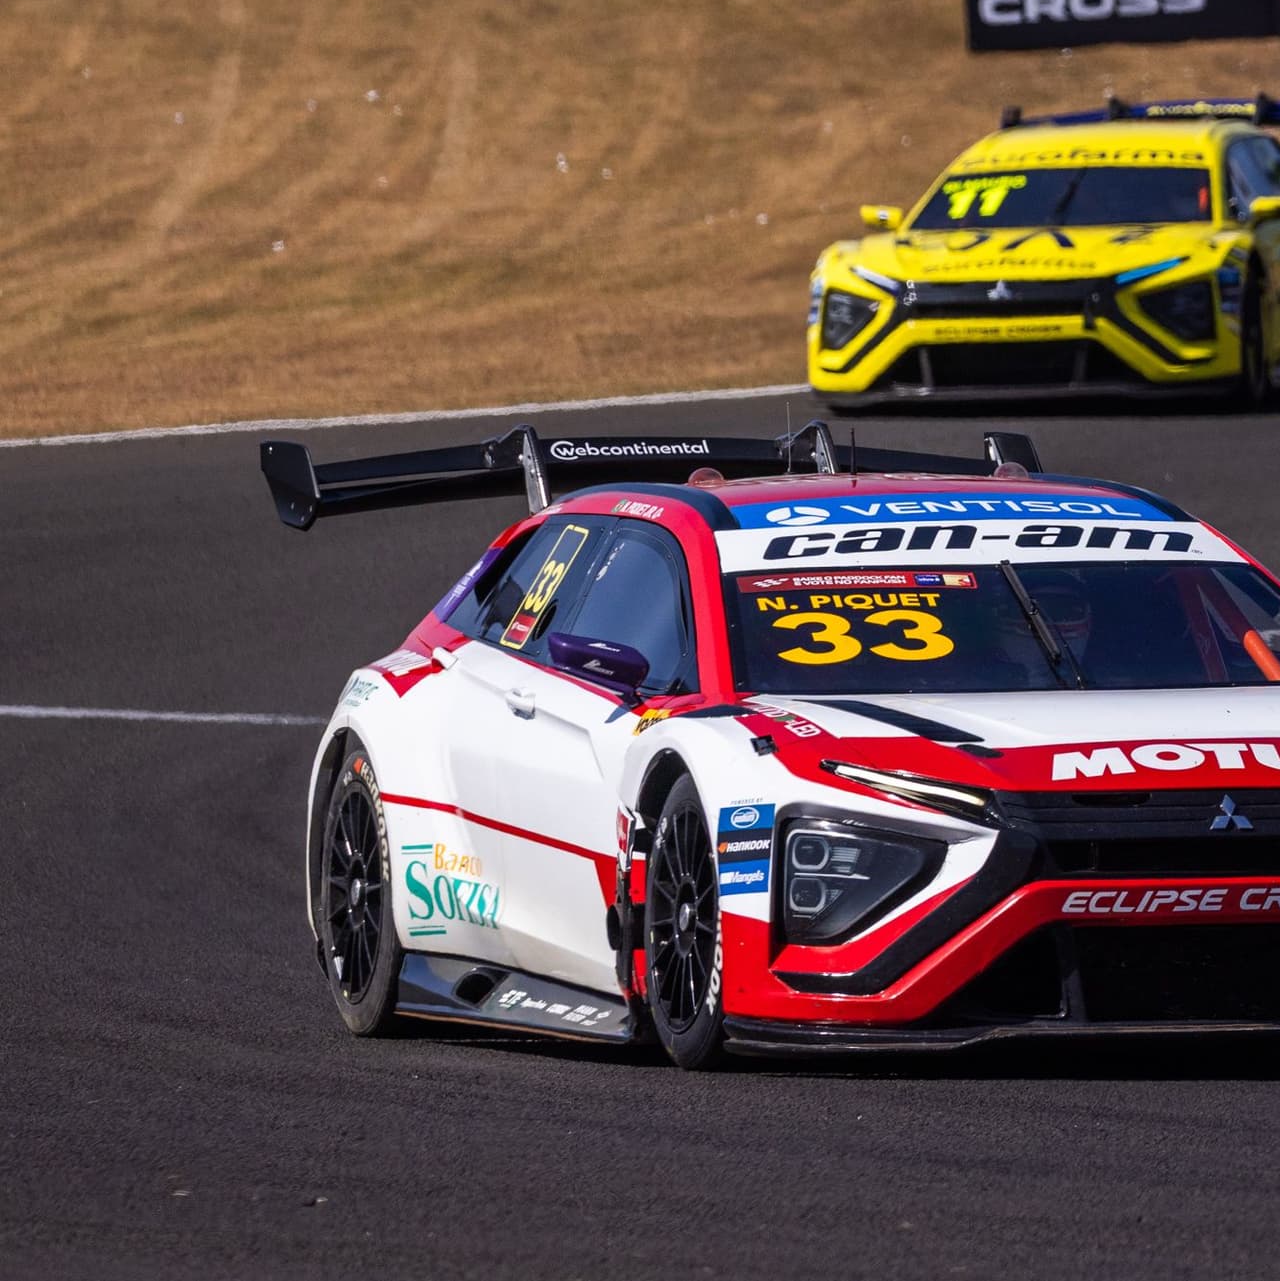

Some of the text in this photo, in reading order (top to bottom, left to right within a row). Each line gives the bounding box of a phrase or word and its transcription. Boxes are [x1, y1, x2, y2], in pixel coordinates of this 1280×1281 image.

[841, 500, 1142, 517] VENTISOL
[763, 524, 1194, 561] can-am
[757, 593, 940, 611] N. PIQUET
[773, 610, 955, 665] 33
[1061, 888, 1229, 914] ECLIPSE
